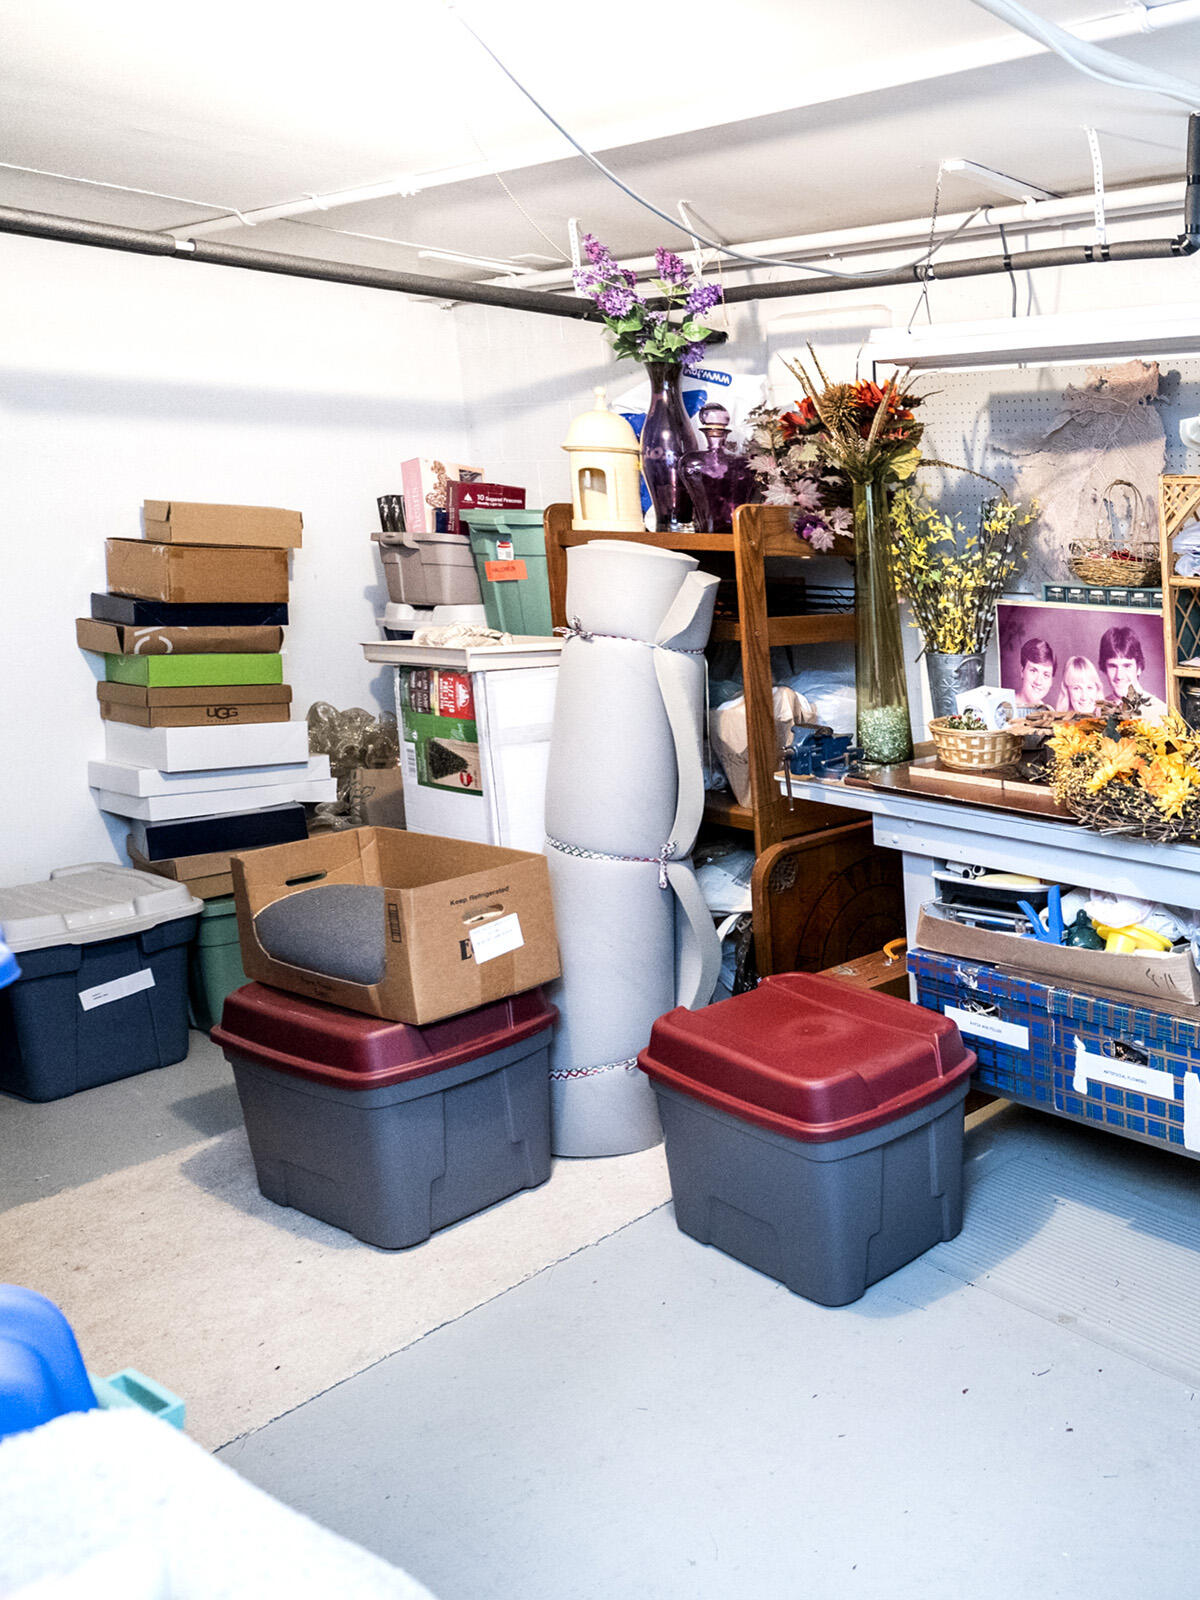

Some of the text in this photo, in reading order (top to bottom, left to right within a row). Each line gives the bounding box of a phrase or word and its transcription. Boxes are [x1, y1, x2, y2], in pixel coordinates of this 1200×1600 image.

[476, 493, 485, 501] 10
[206, 706, 239, 719] UGG
[450, 886, 510, 906] Keep Refrigerated
